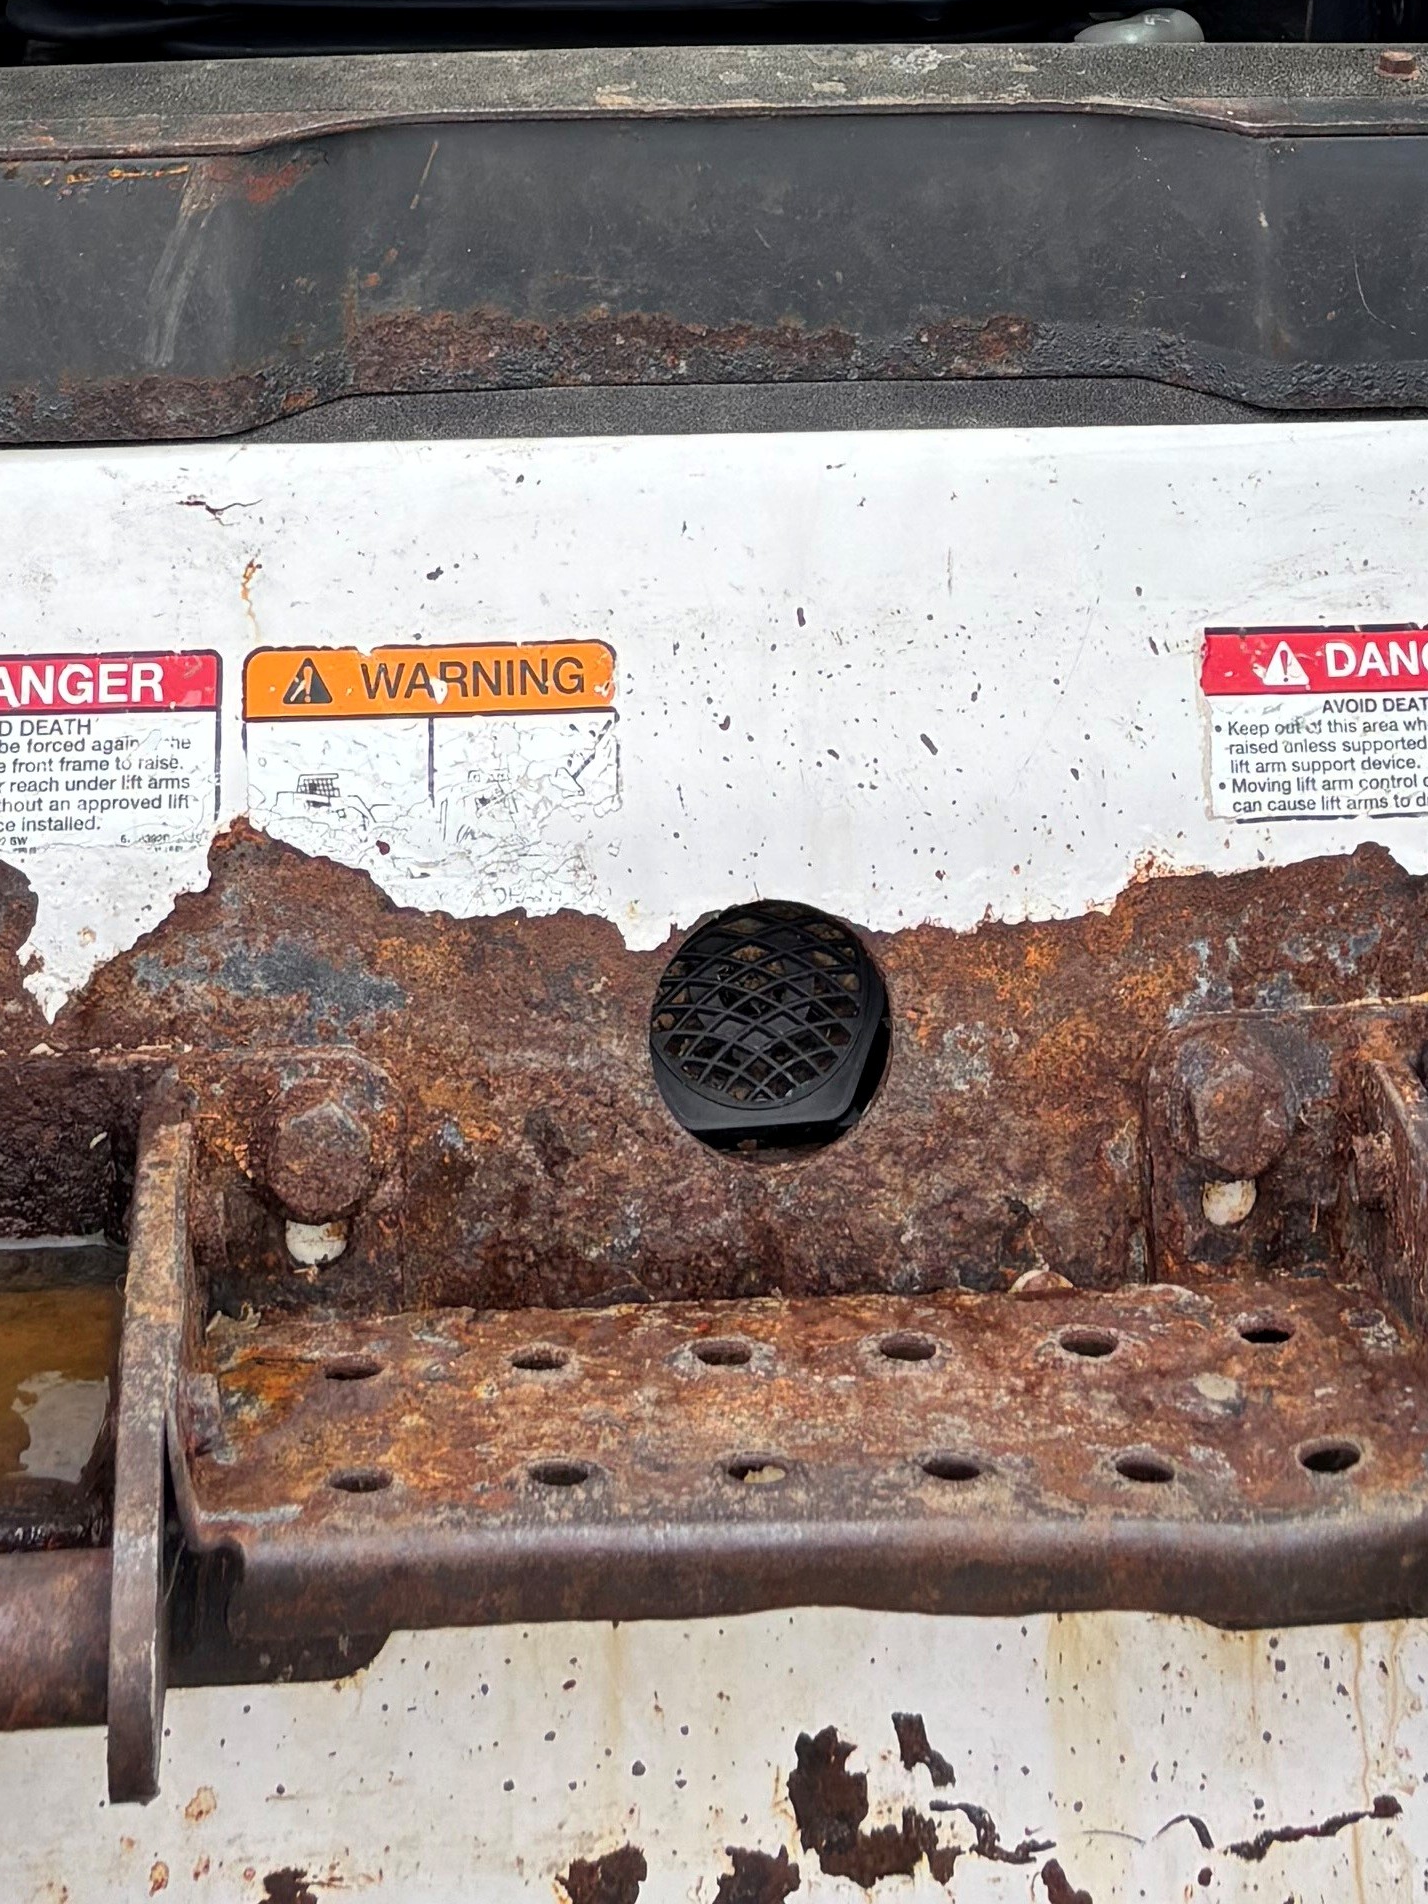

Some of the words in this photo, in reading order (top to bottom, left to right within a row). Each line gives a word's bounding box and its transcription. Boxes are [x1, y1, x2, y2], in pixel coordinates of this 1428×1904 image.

[361, 657, 585, 699] WARNING
[1323, 698, 1377, 713] AVOID
[20, 719, 91, 736] DEATH
[1228, 721, 1269, 737] Keep
[1275, 721, 1301, 734] out
[1327, 720, 1357, 733] this
[1363, 721, 1398, 732] area
[27, 739, 85, 753] forced
[92, 737, 142, 754] again
[1229, 741, 1278, 754] raised
[1283, 739, 1336, 753] unless
[1343, 738, 1427, 754] supported
[13, 759, 52, 773] front
[61, 757, 109, 771] frame
[116, 757, 131, 770] to
[139, 755, 183, 770] raise.
[1231, 760, 1250, 773] lift
[1256, 761, 1286, 773] arm
[1292, 757, 1355, 773] support
[1361, 756, 1421, 770] device.
[10, 777, 59, 793] reach
[66, 777, 116, 790] under
[148, 776, 189, 789] arms
[1232, 777, 1291, 794] Moving
[1297, 777, 1317, 792] lift
[1322, 779, 1353, 790] arm
[1360, 773, 1417, 791] control
[50, 799, 70, 811] an
[78, 795, 162, 813] approved
[168, 795, 189, 808] lift
[1233, 800, 1261, 812] can
[1268, 798, 1316, 810] cause
[1322, 797, 1341, 810] lift
[1347, 797, 1388, 809] arms
[1394, 793, 1410, 807] to
[22, 817, 100, 831] installed.
